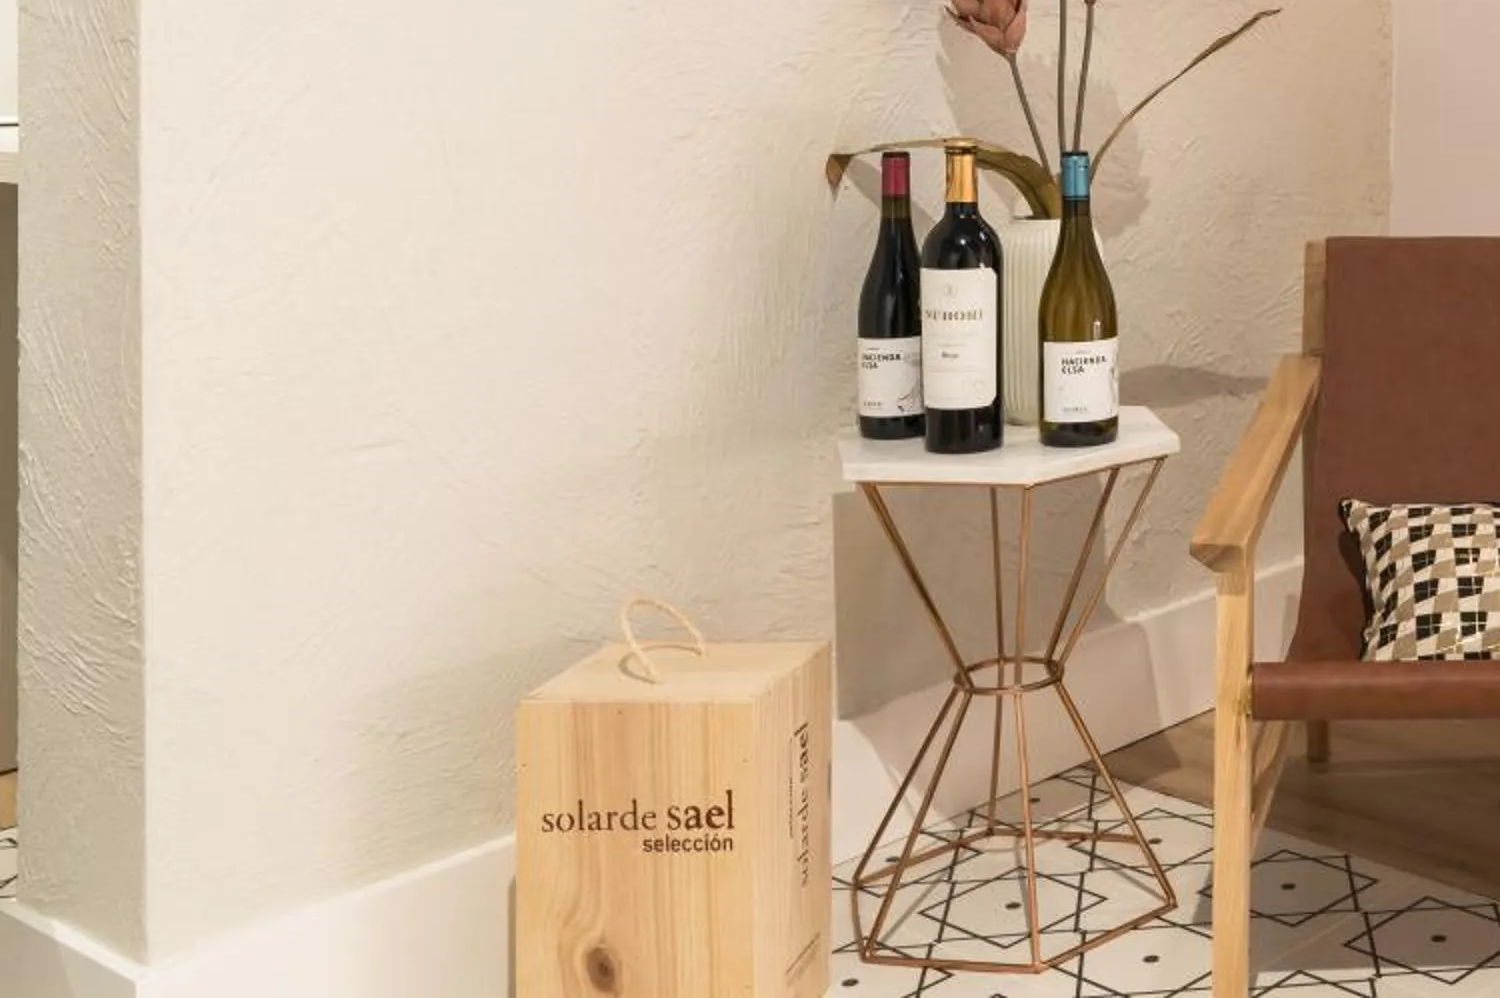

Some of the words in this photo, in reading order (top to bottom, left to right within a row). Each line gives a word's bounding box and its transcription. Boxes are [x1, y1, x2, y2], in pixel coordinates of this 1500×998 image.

[541, 798, 657, 833] solarde
[667, 789, 735, 831] sael
[642, 833, 734, 853] selección
